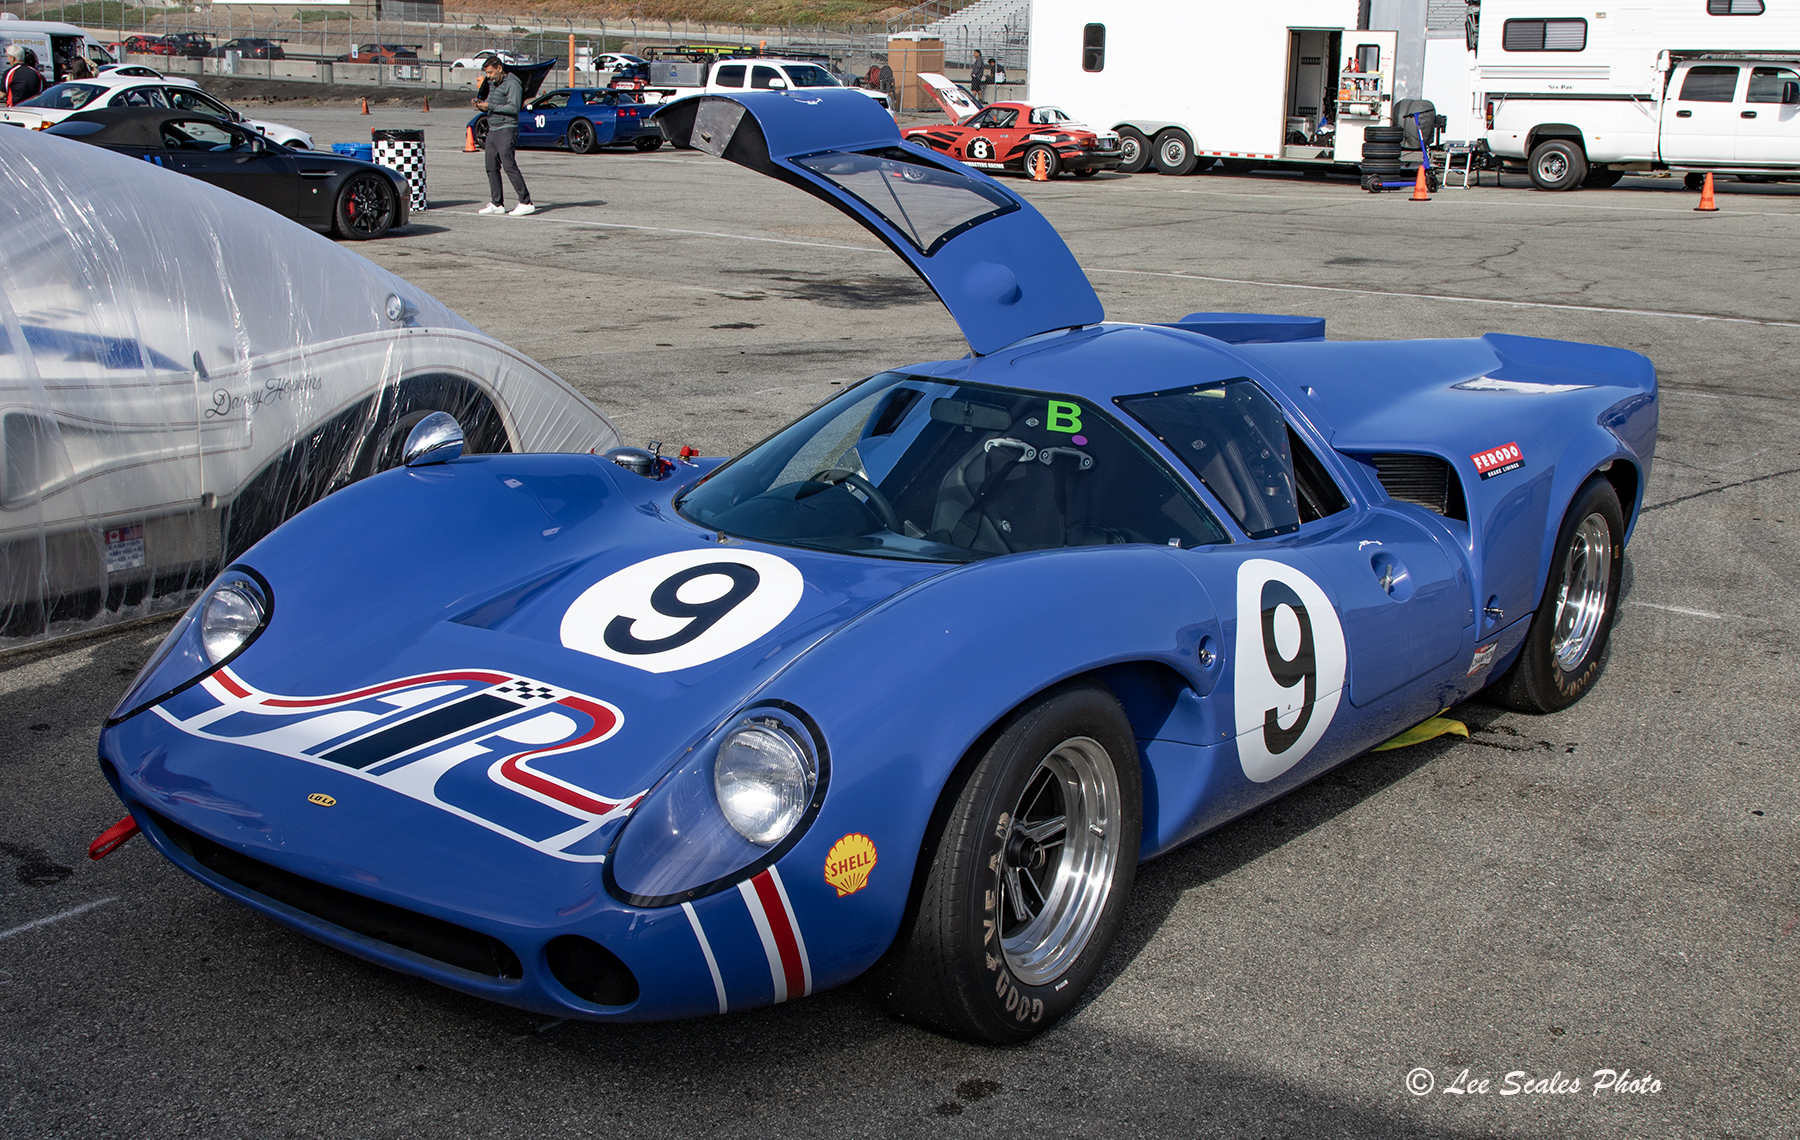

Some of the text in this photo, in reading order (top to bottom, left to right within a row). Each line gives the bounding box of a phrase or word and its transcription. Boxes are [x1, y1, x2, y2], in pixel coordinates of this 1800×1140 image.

[534, 114, 546, 128] 10
[973, 141, 988, 159] 8
[1046, 399, 1083, 434] B
[1473, 445, 1519, 470] FERODO
[603, 561, 761, 655] 9
[1261, 579, 1318, 756] 9
[309, 794, 335, 806] LOLA
[830, 851, 871, 878] SHELL
